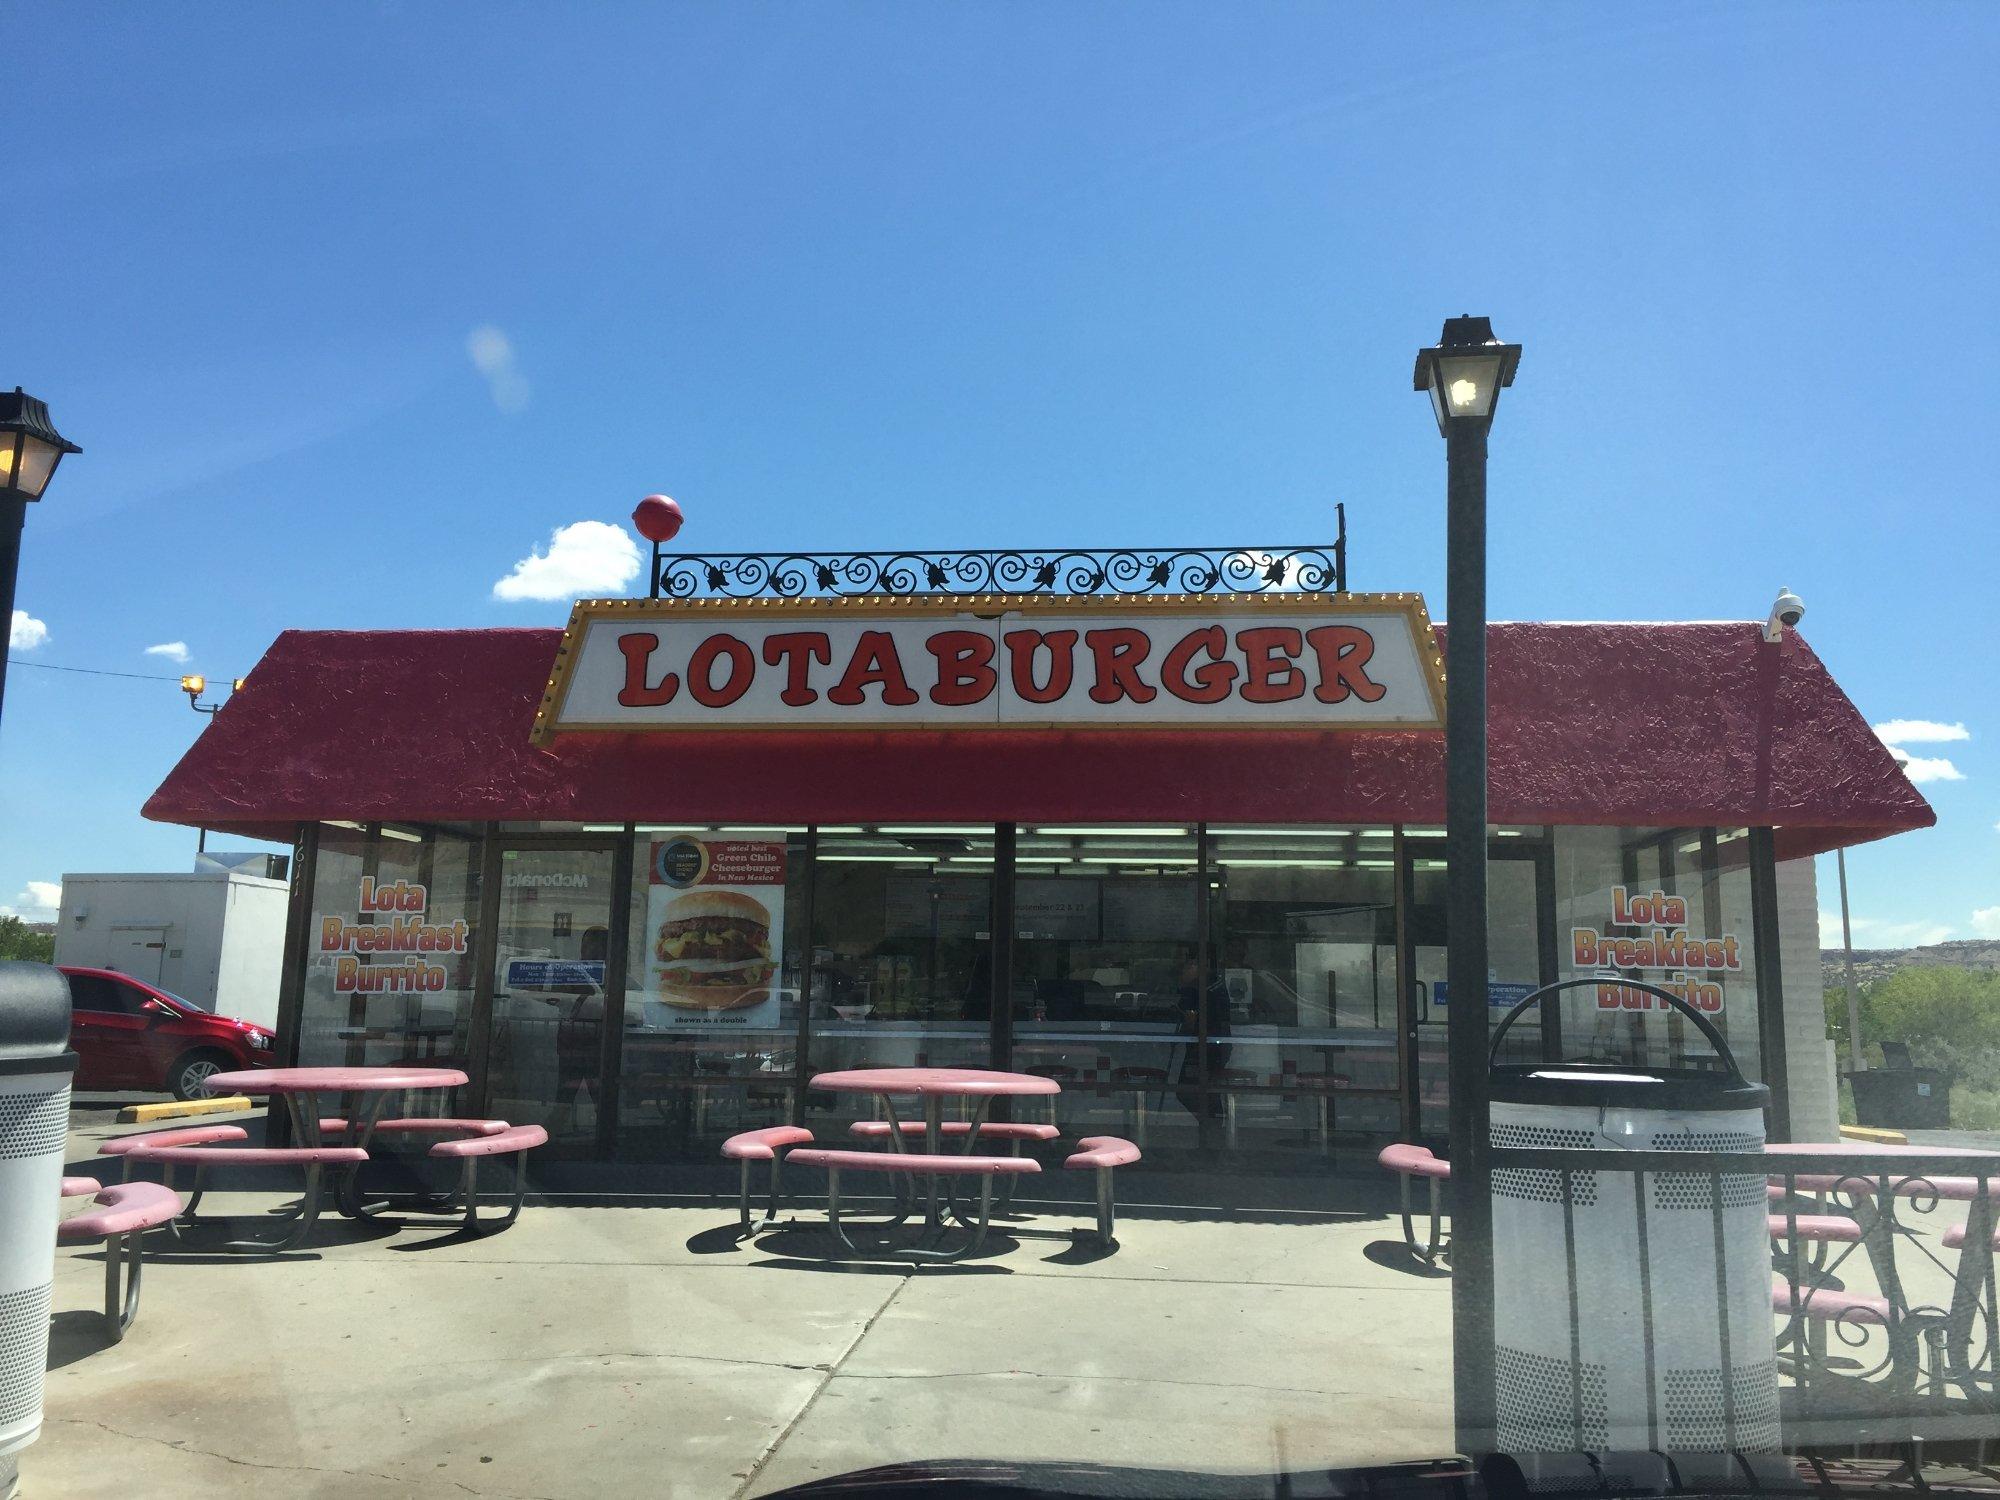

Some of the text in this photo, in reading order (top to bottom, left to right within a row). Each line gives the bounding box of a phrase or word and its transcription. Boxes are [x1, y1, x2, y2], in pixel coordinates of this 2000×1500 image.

[617, 624, 1387, 709] LOTABURGER
[711, 863, 782, 874] Cheeseburger
[716, 853, 778, 862] Green Chile
[360, 877, 426, 913] Lota
[728, 873, 746, 881] New
[746, 873, 775, 881] Mexico
[1613, 887, 1687, 926] Lota
[320, 916, 467, 953] Breakfast
[1572, 928, 1741, 969] Breakfast
[335, 956, 446, 993] Burrito
[1487, 986, 1527, 995] peration
[1596, 972, 1723, 1011] Burrito
[674, 1016, 701, 1024] shown
[720, 1016, 747, 1024] double
